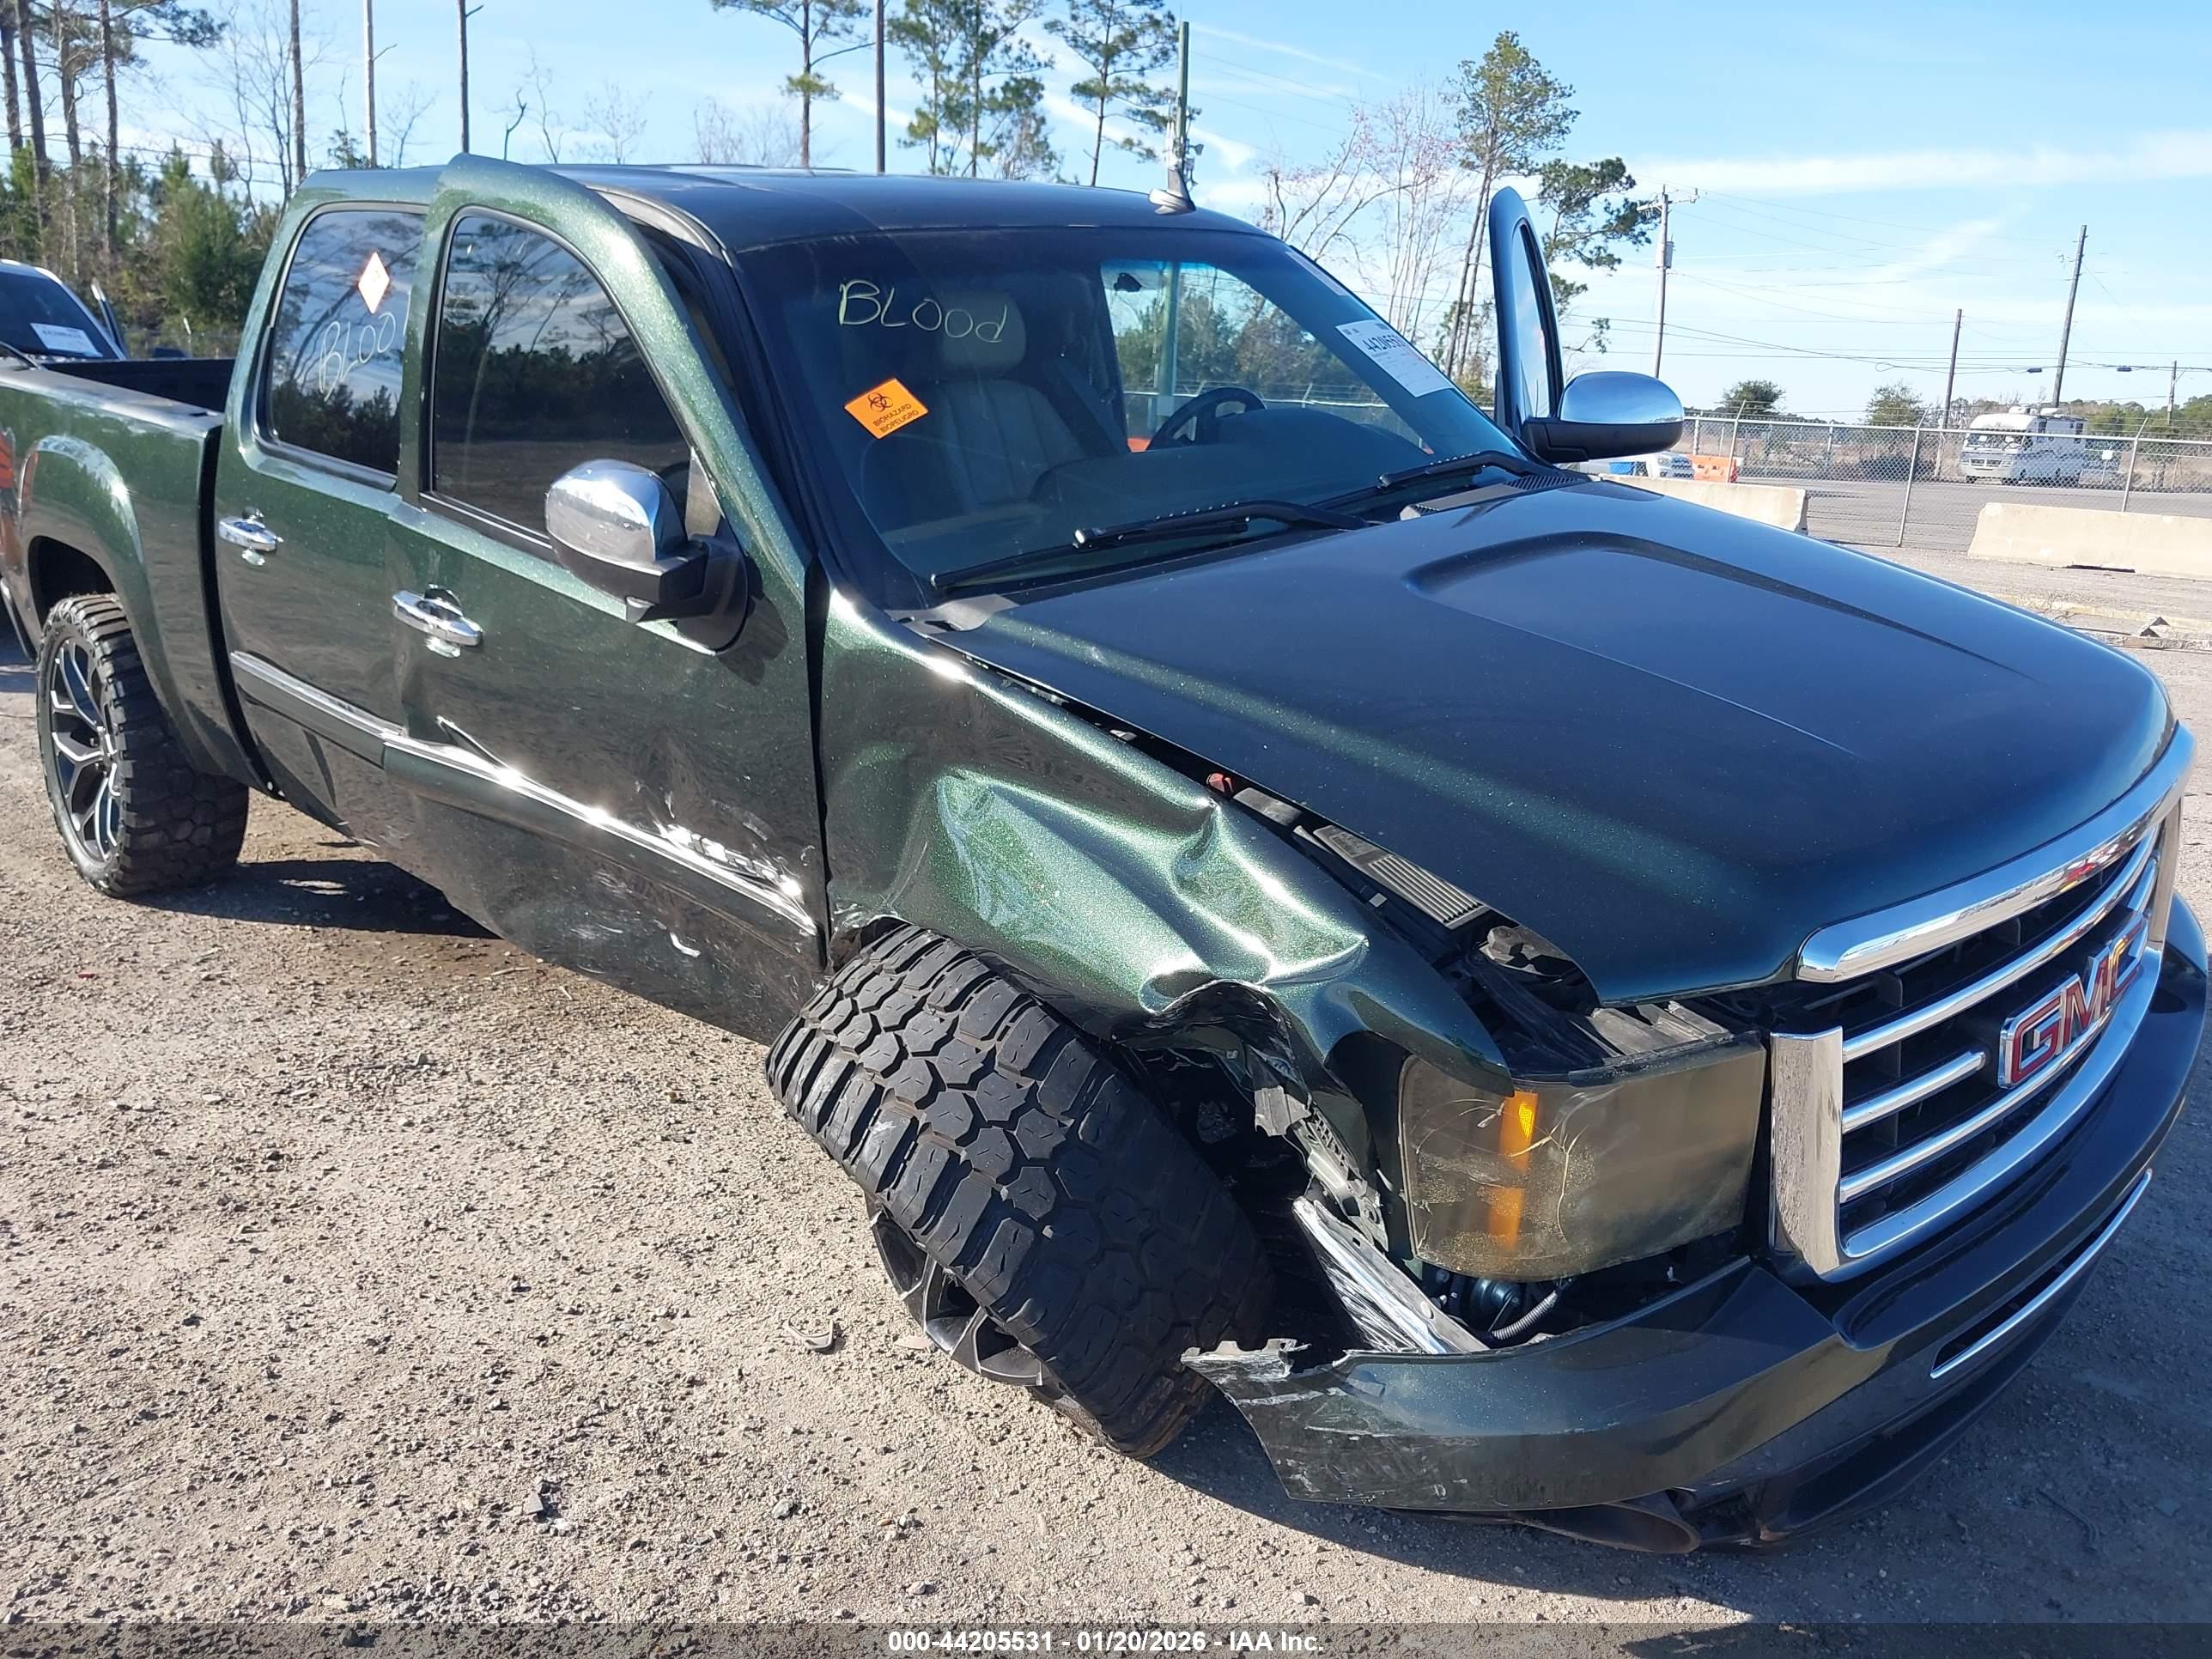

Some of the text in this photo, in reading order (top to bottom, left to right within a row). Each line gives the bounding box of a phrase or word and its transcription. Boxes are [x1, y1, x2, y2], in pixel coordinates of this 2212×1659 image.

[872, 403, 912, 427] BIOHAZARD
[879, 410, 919, 434] BIOPELIGRO
[1998, 913, 2148, 1090] GMC
